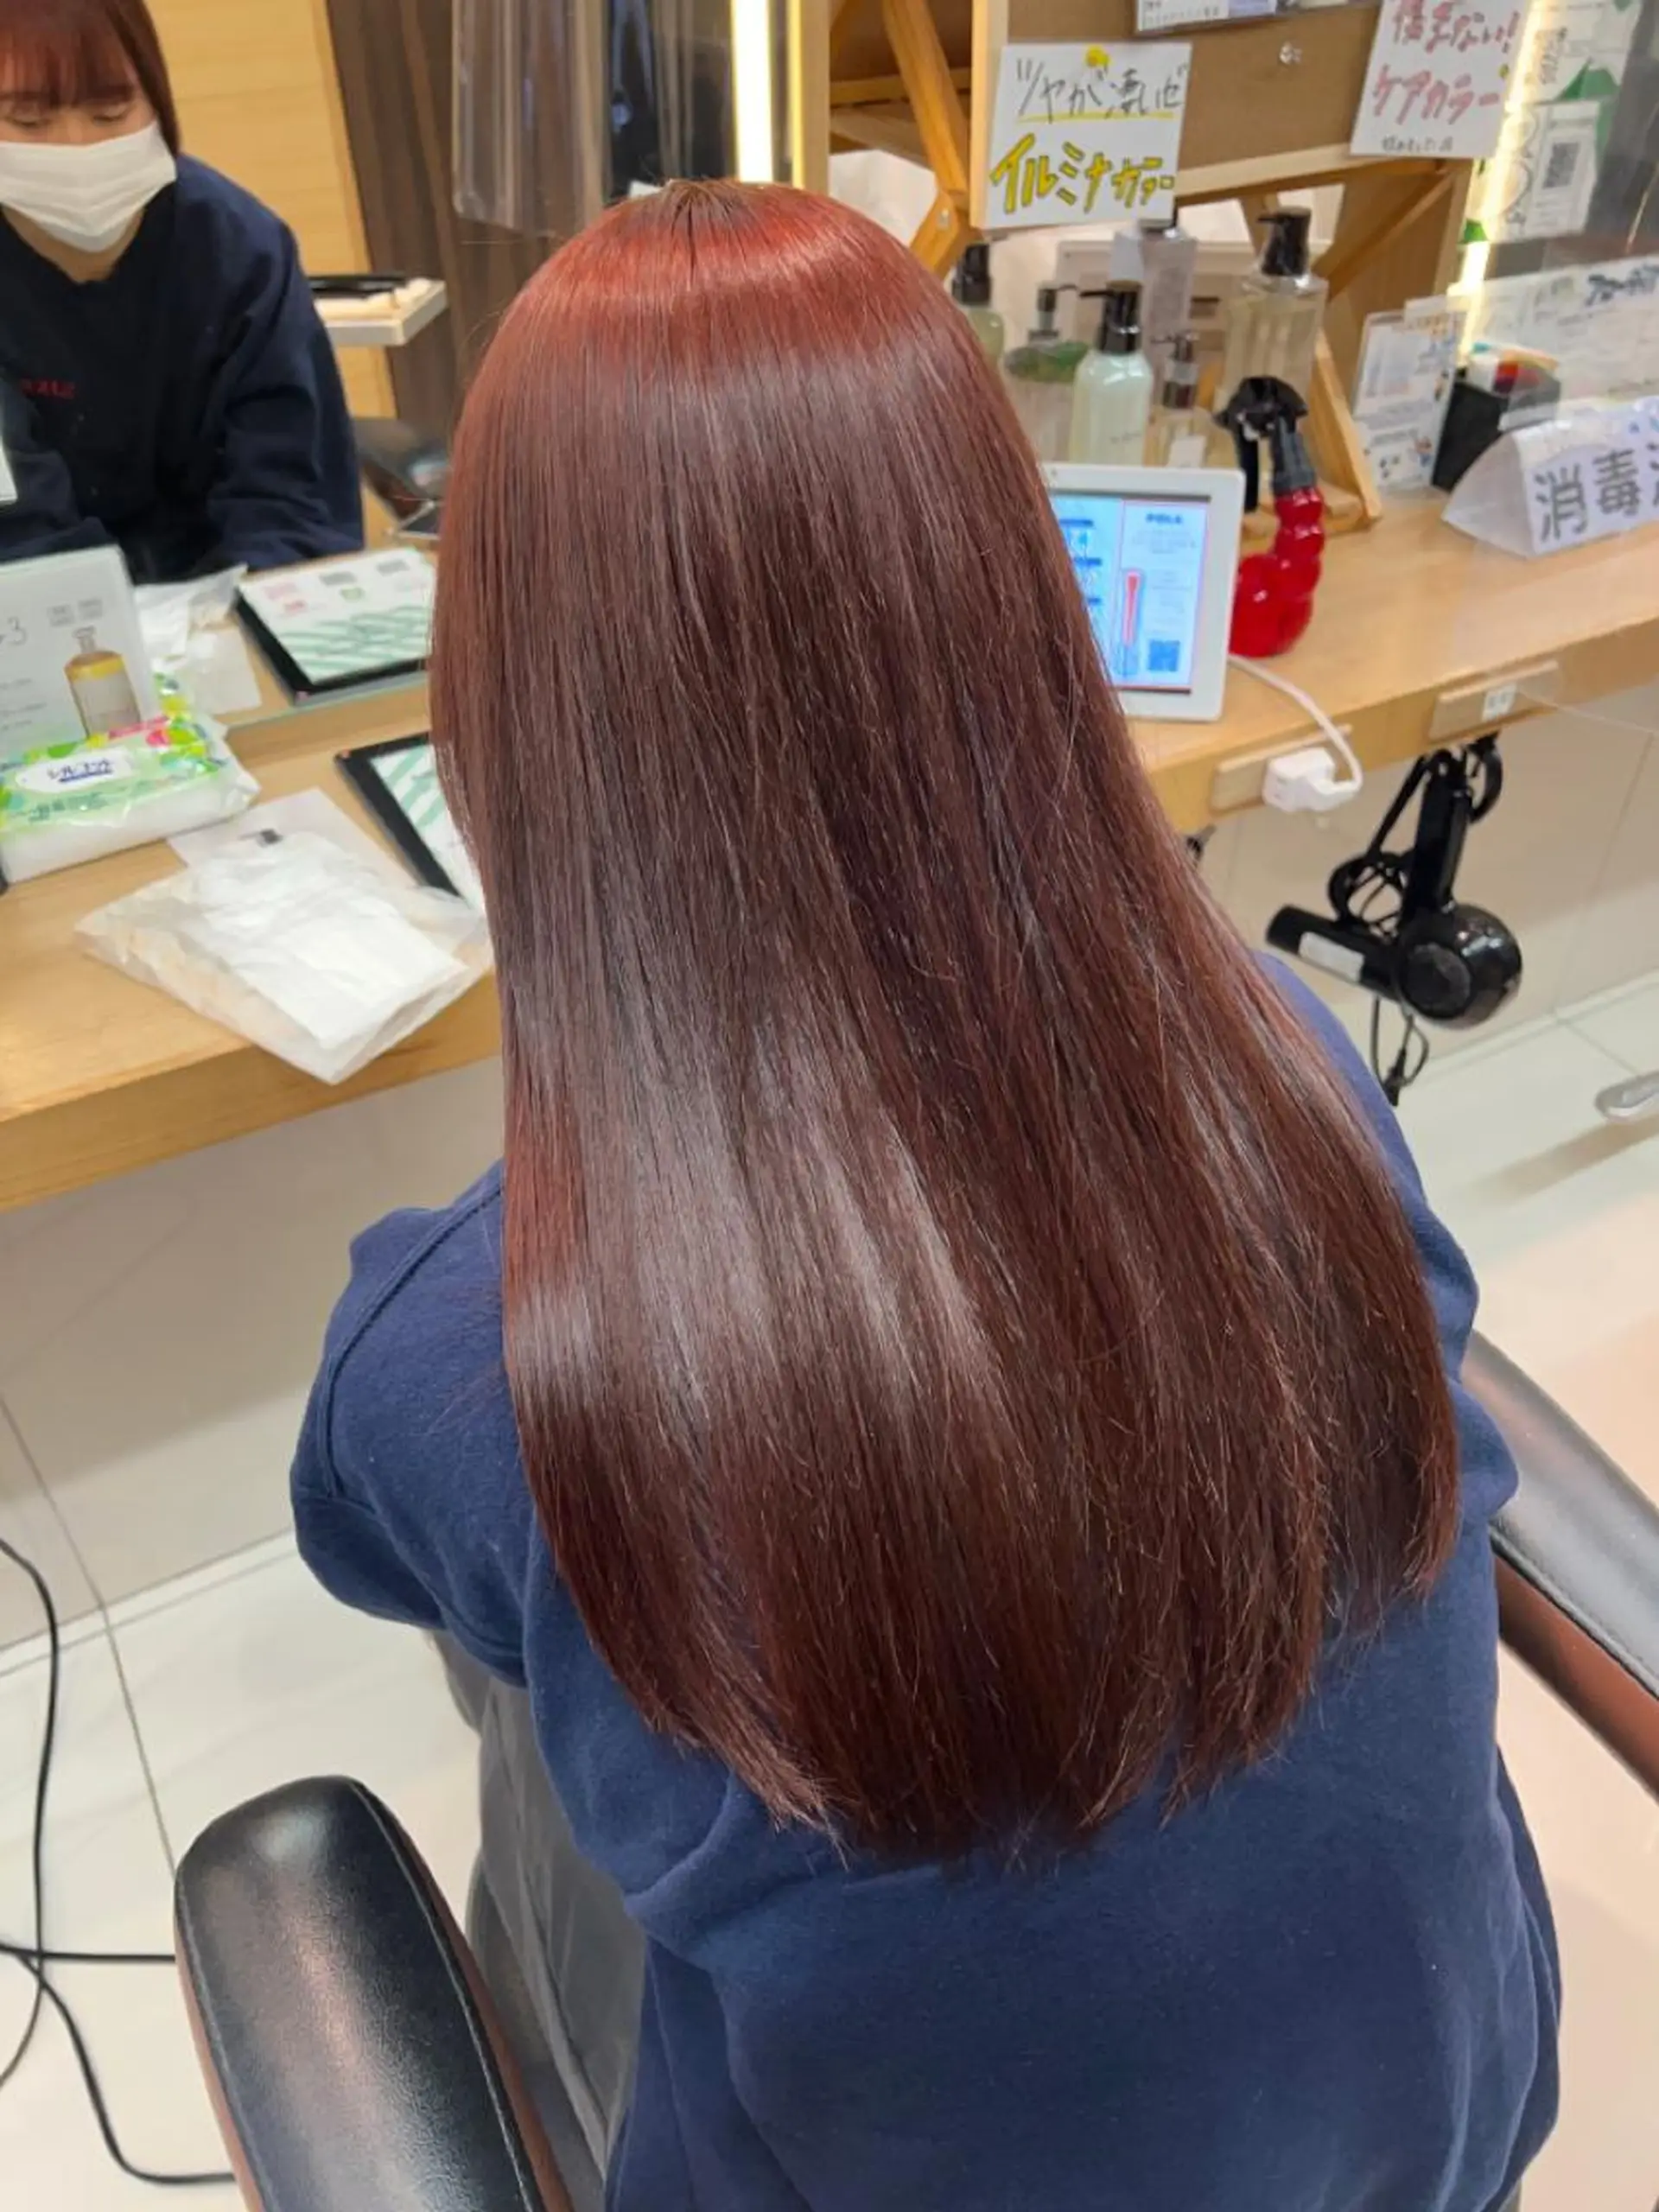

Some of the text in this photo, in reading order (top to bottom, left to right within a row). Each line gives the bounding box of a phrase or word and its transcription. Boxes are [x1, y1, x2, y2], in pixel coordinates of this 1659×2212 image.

[1373, 64, 1501, 126] ケアカラー
[989, 131, 1175, 213] イルミナカラー
